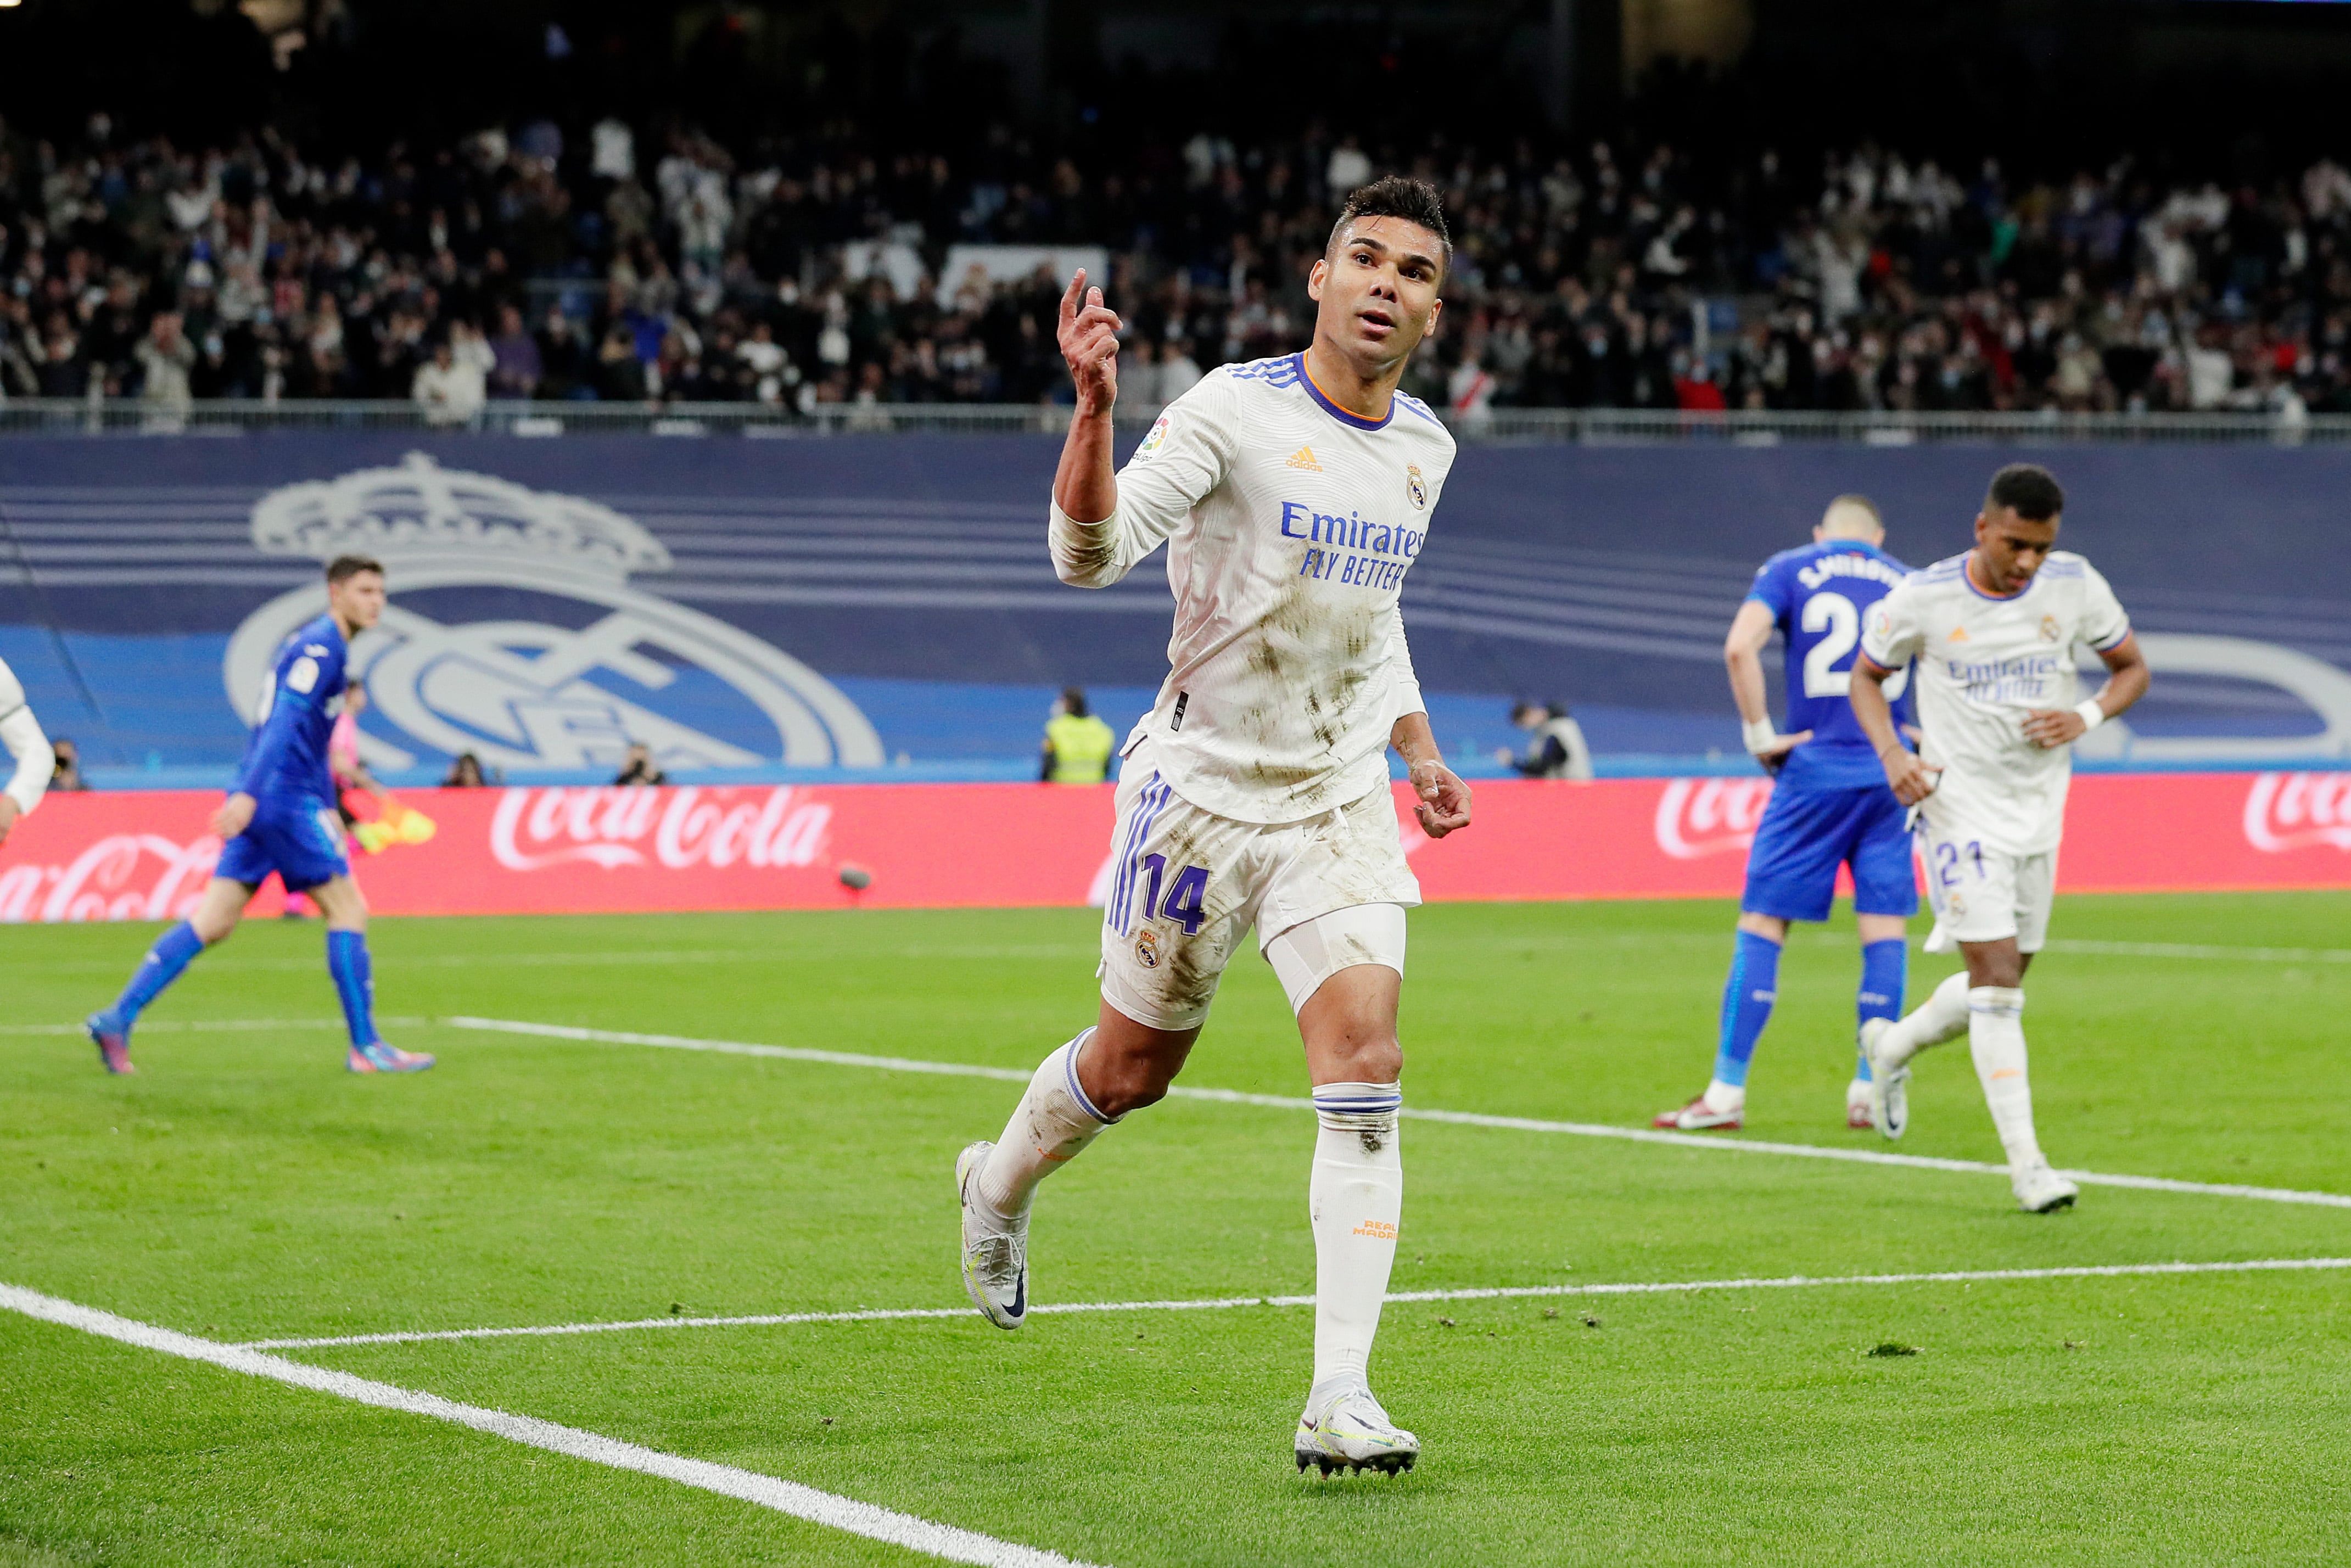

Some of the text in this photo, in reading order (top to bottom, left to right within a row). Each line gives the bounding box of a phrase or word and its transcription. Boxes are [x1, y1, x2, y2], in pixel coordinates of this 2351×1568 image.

[1132, 452, 1153, 462] aLiga
[1285, 459, 1323, 473] adidas
[1281, 501, 1424, 558] Emirates
[1300, 548, 1404, 591] FLY BETTER
[1936, 841, 1986, 888] 21
[1141, 853, 1209, 937] 14
[1364, 1220, 1396, 1231] REAL
